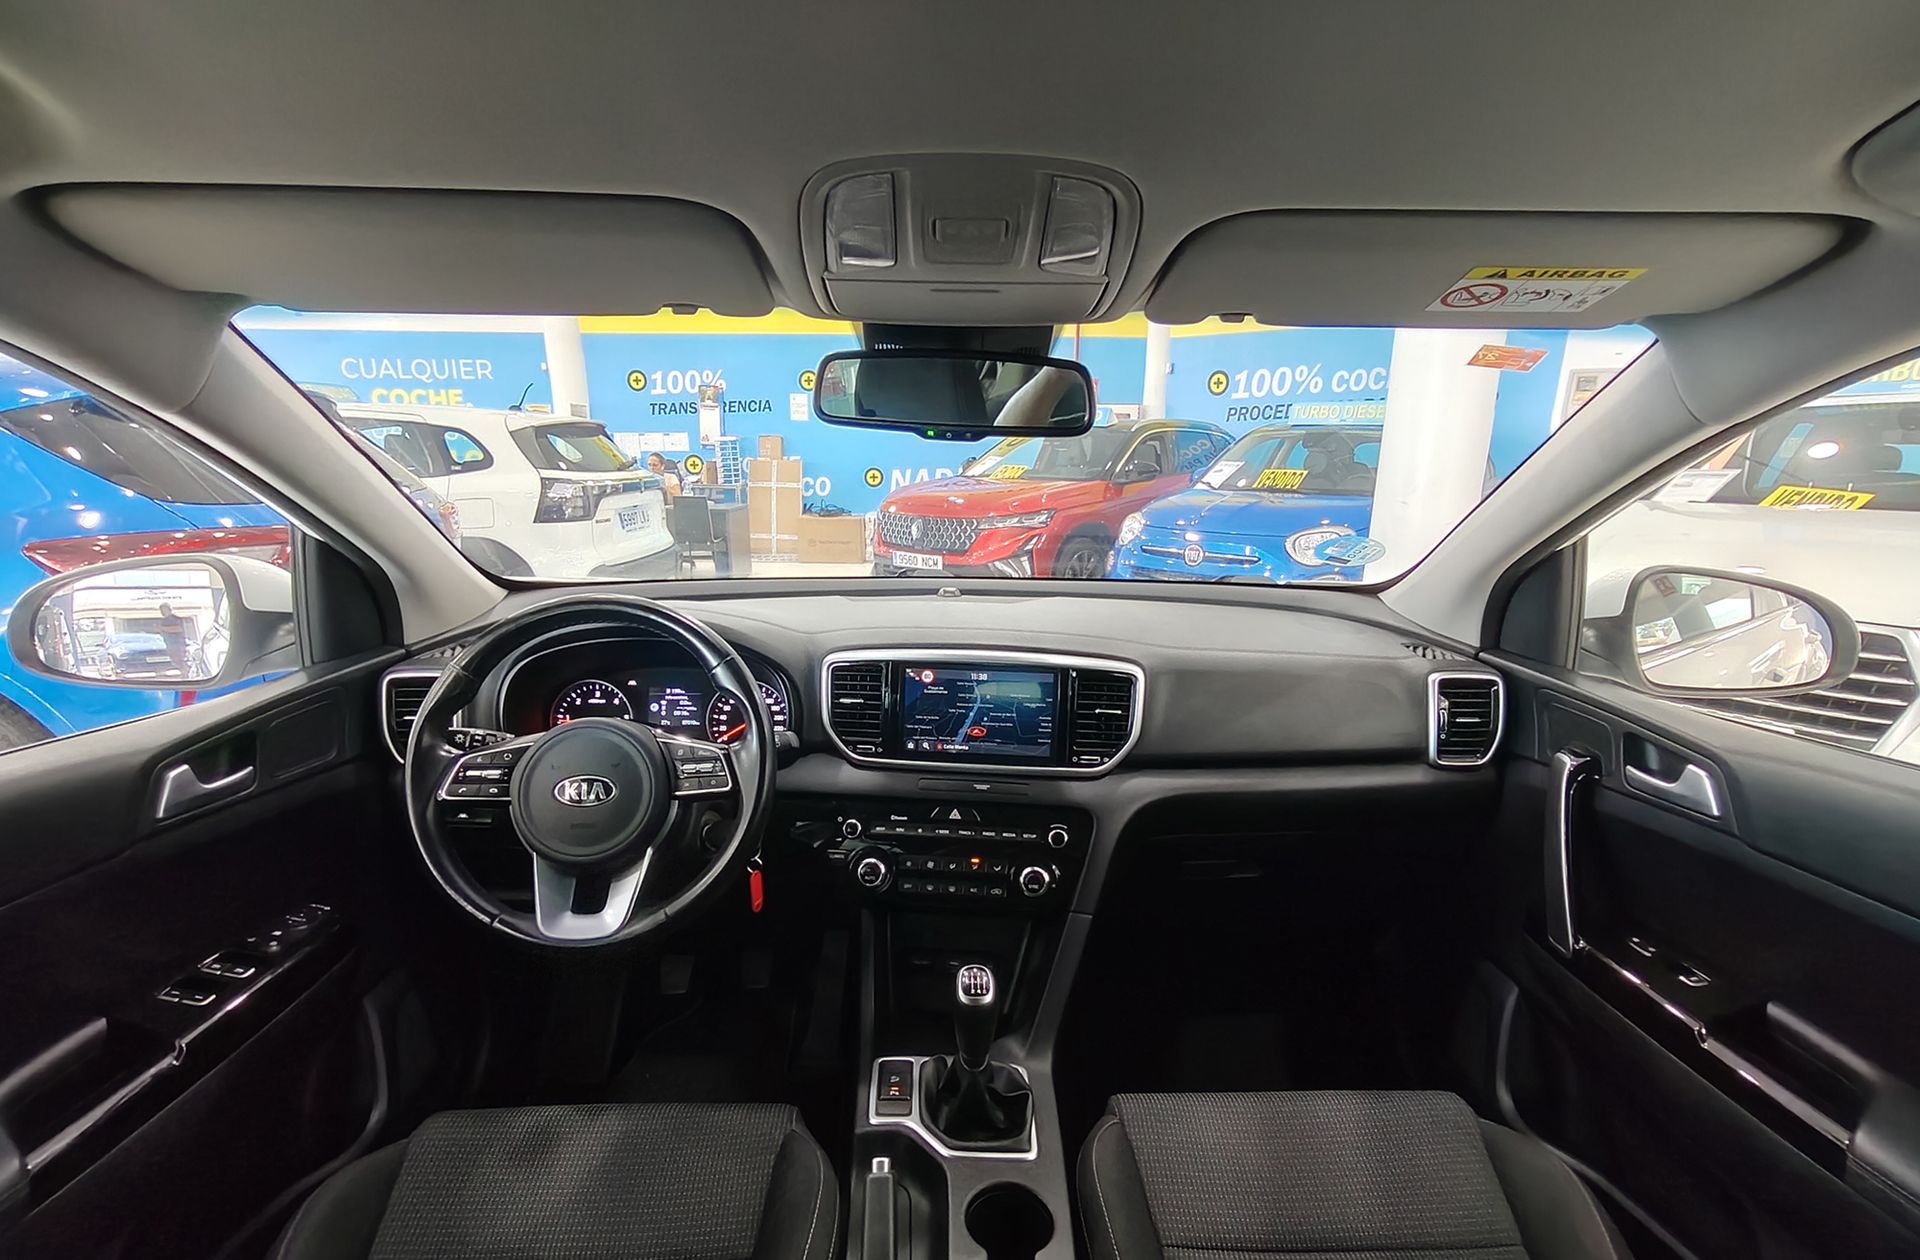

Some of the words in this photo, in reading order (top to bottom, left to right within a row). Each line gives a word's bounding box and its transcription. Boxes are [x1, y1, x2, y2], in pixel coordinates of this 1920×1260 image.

[1517, 269, 1630, 279] AIRBAG
[340, 357, 493, 383] CUALQUIER
[650, 369, 727, 396] 100%
[1231, 363, 1324, 400] 100%
[370, 387, 464, 407] COCHE
[1294, 404, 1340, 420] TURBO
[1259, 470, 1305, 488] VENDIDO
[921, 557, 939, 569] NCM
[564, 781, 607, 800] KIA
